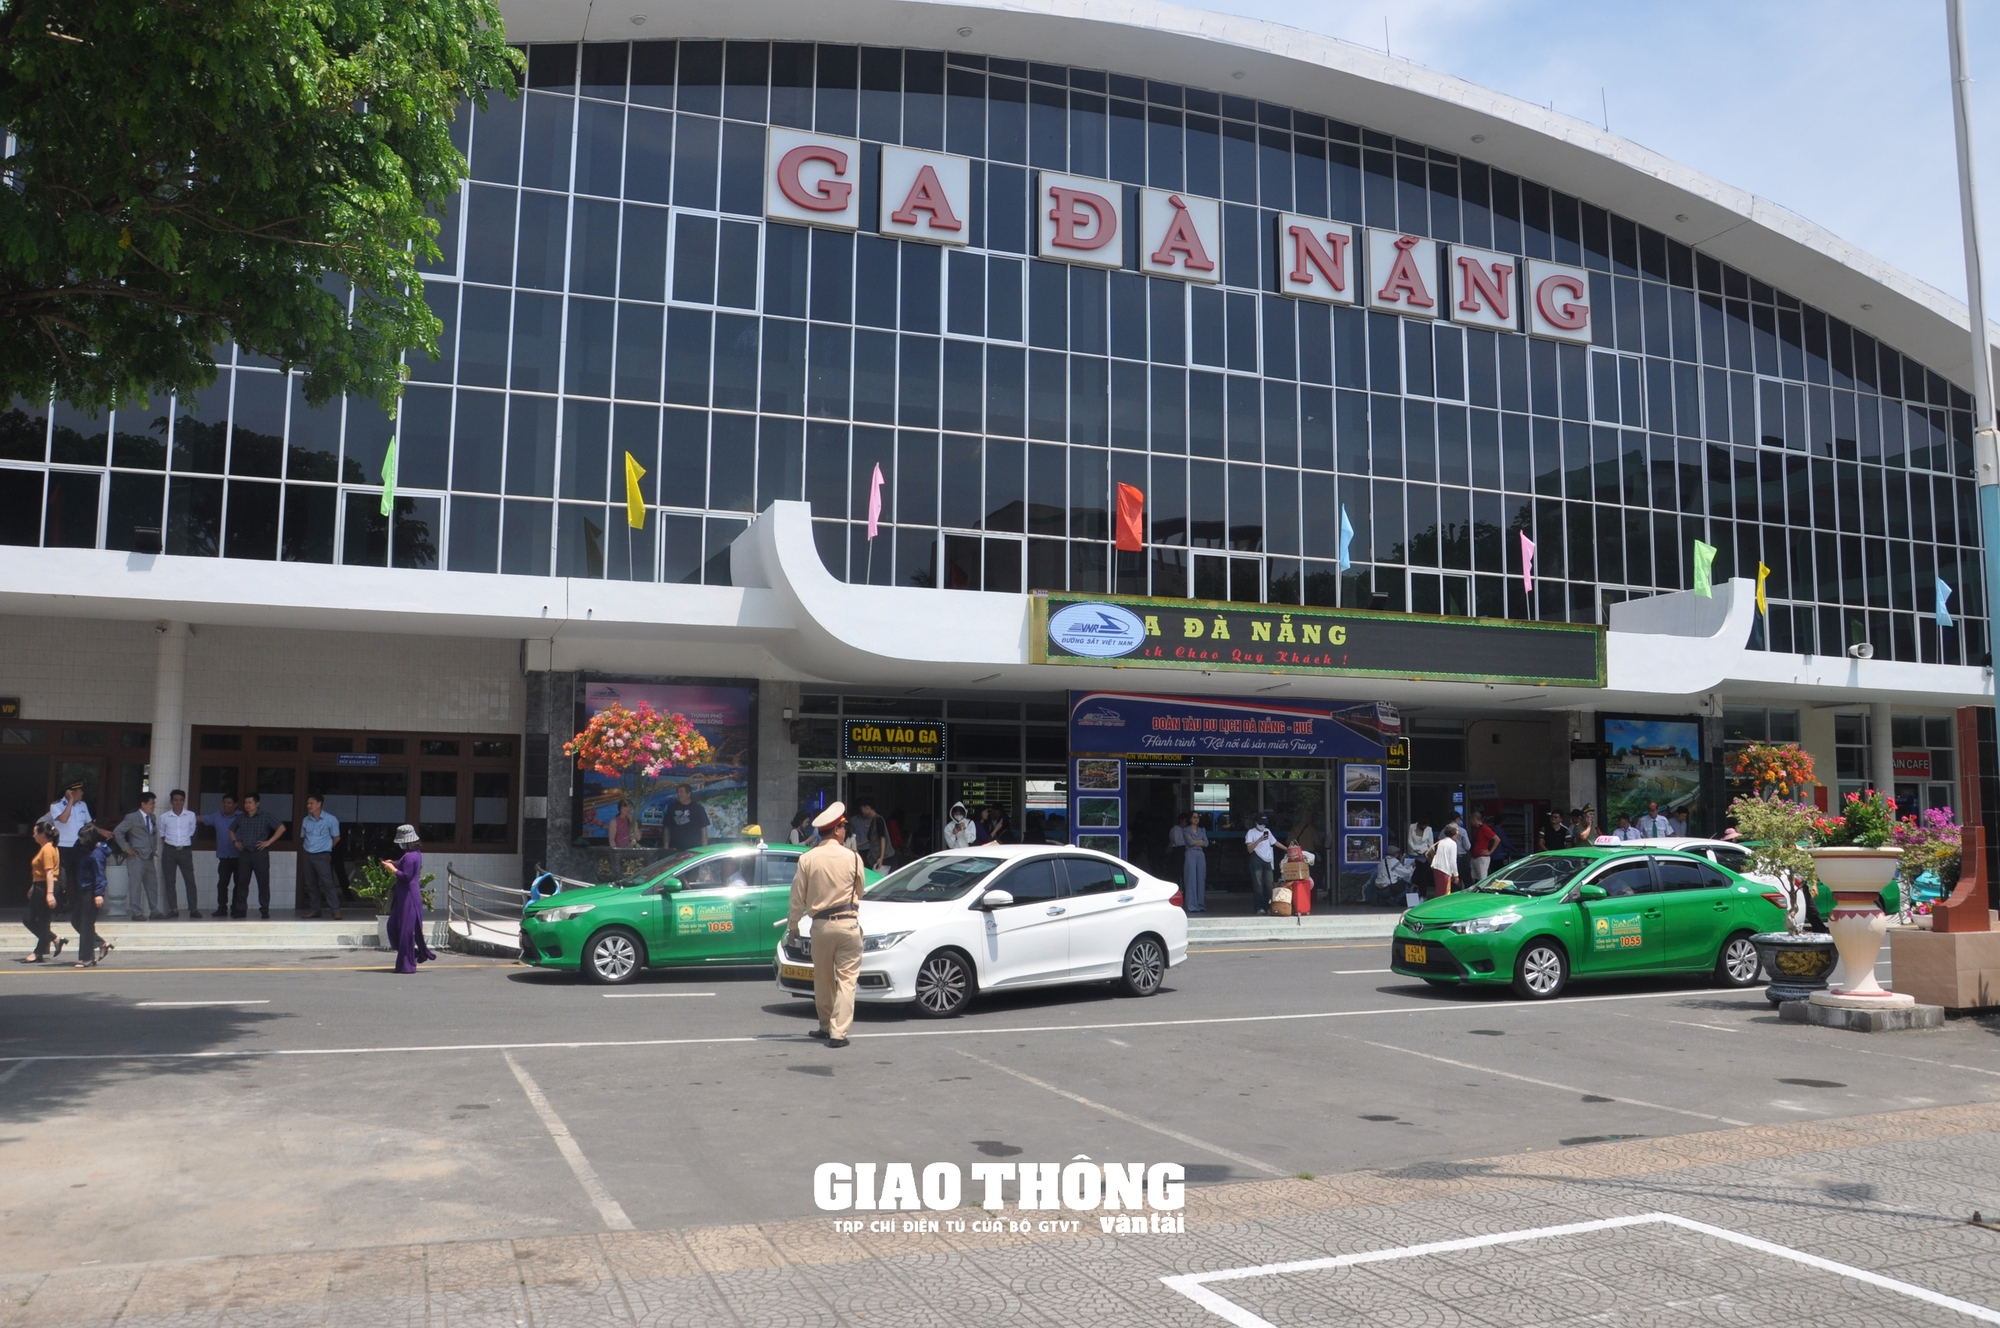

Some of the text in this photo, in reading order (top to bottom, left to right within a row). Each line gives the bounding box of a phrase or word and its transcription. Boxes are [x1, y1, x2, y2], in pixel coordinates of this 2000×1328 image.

[777, 144, 1591, 331] GA ĐÀ NẴNG
[1184, 614, 1231, 640] ĐÀ
[1251, 614, 1347, 646] NẴNG
[1275, 650, 1332, 665] Khách
[1152, 715, 1181, 731] ĐOÀN
[1182, 716, 1201, 731] TÀU
[1203, 719, 1217, 732] DU
[1219, 719, 1242, 735] LỊCH
[1243, 717, 1257, 733] ĐÀ
[1293, 718, 1313, 735] HUẾ
[852, 724, 937, 743] CỬA VÀO GA
[1142, 734, 1173, 749] Hành
[1174, 736, 1196, 747] trình
[1241, 737, 1251, 749] di
[1390, 743, 1404, 755] GA
[858, 745, 932, 754] STATION ENTRANCE
[1907, 759, 1929, 769] CAFE
[708, 921, 733, 932] 1055
[1620, 935, 1642, 947] 1055
